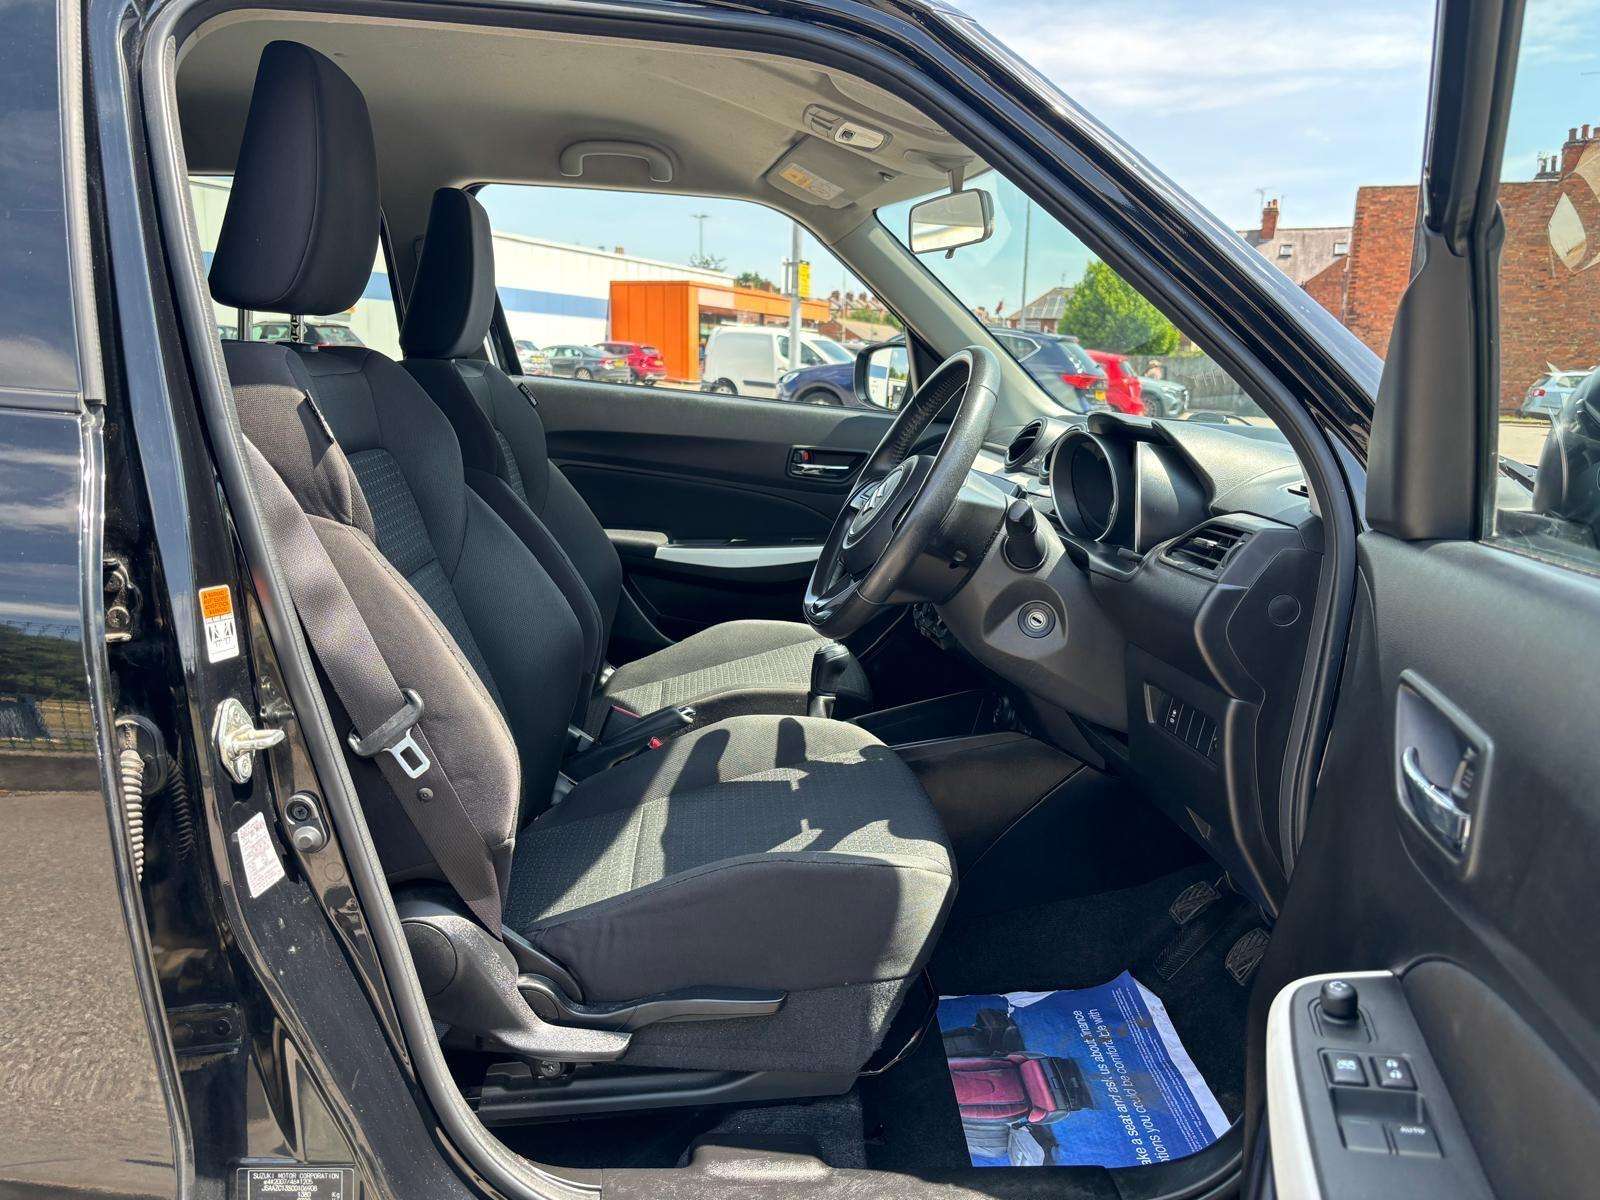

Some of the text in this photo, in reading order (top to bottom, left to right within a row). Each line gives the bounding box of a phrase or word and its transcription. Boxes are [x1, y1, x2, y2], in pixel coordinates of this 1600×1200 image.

[1088, 1008, 1103, 1025] with
[1084, 1038, 1104, 1062] about
[1097, 1025, 1127, 1074] comfortble
[1098, 1063, 1110, 1075] us
[1121, 1075, 1134, 1087] be
[1108, 1094, 1127, 1112] and
[1123, 1088, 1146, 1113] could
[1118, 1115, 1139, 1136] seat
[1139, 1115, 1160, 1133] you
[1136, 1147, 1152, 1165] ake
